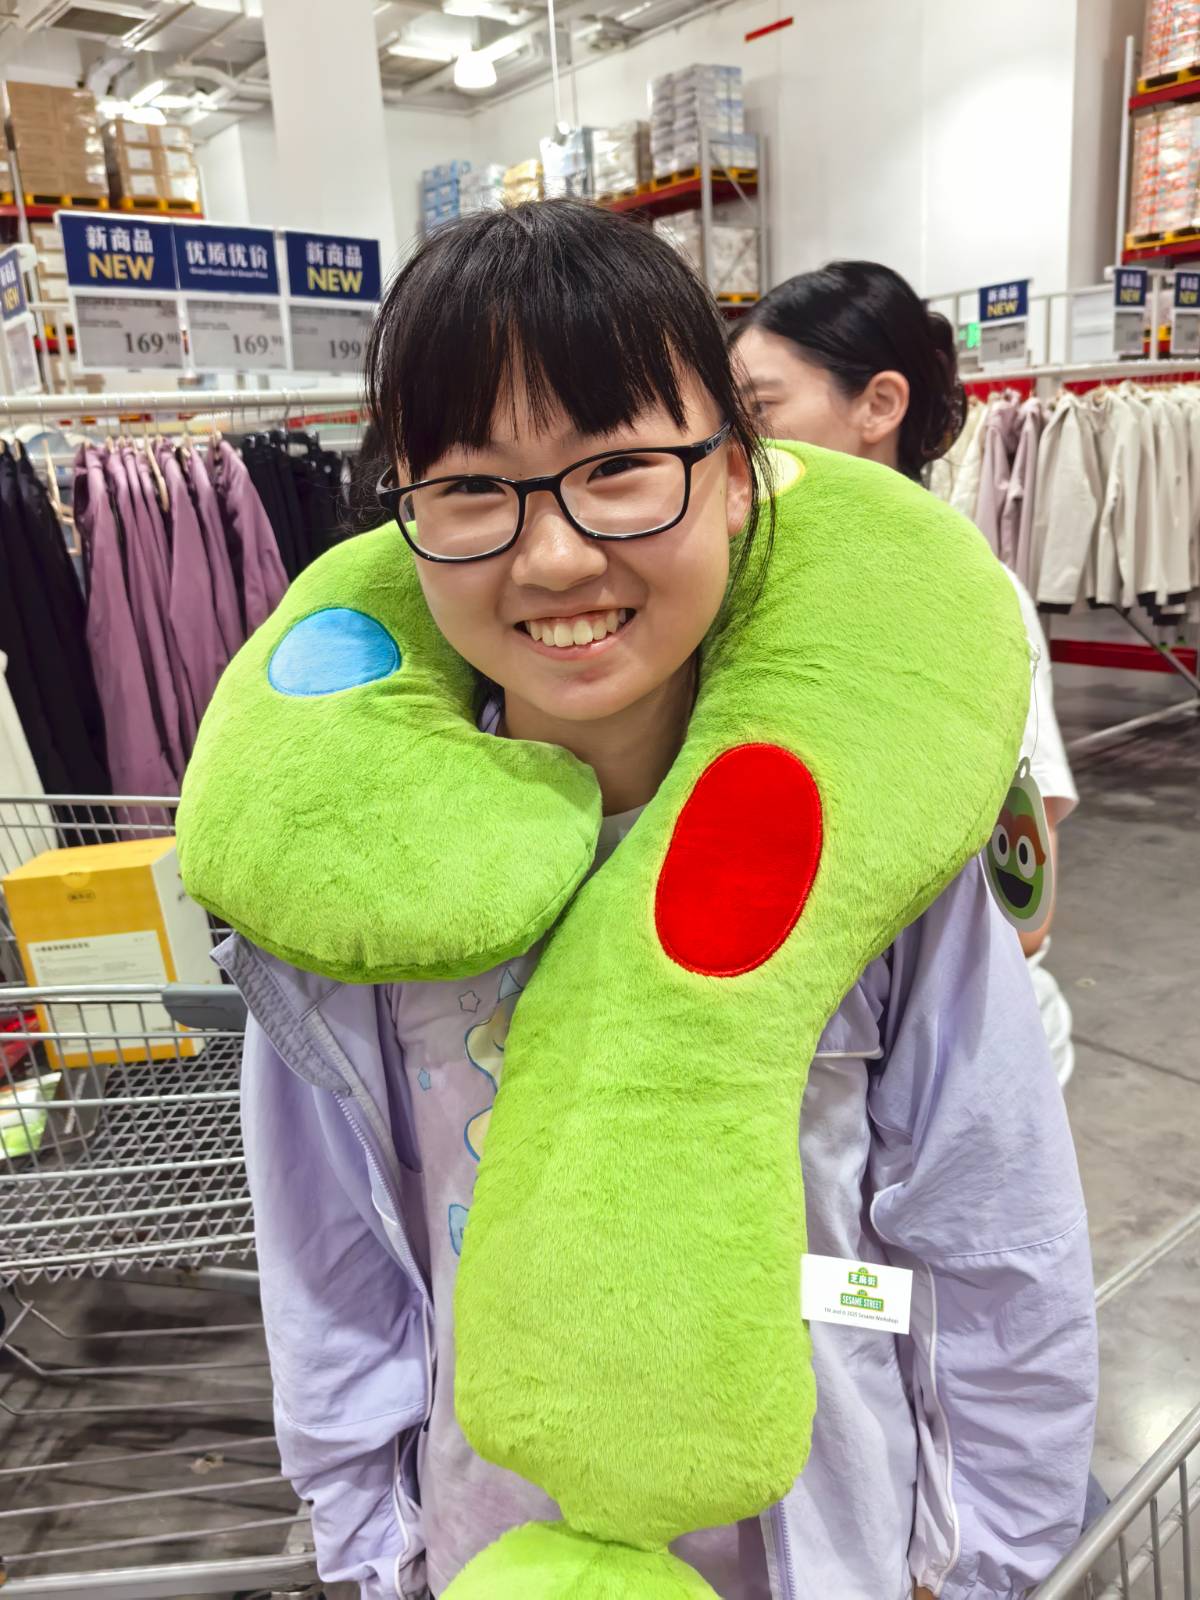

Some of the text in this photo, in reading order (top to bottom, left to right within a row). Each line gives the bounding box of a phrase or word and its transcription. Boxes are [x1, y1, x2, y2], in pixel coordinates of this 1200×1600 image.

[86, 225, 154, 253] 新商品
[88, 252, 155, 281] NEW
[185, 240, 268, 270] 优质优价
[306, 241, 363, 269] 新商品
[307, 266, 363, 294] NEW
[987, 298, 1019, 318] NEW
[842, 1295, 881, 1310] SESAME STREET
